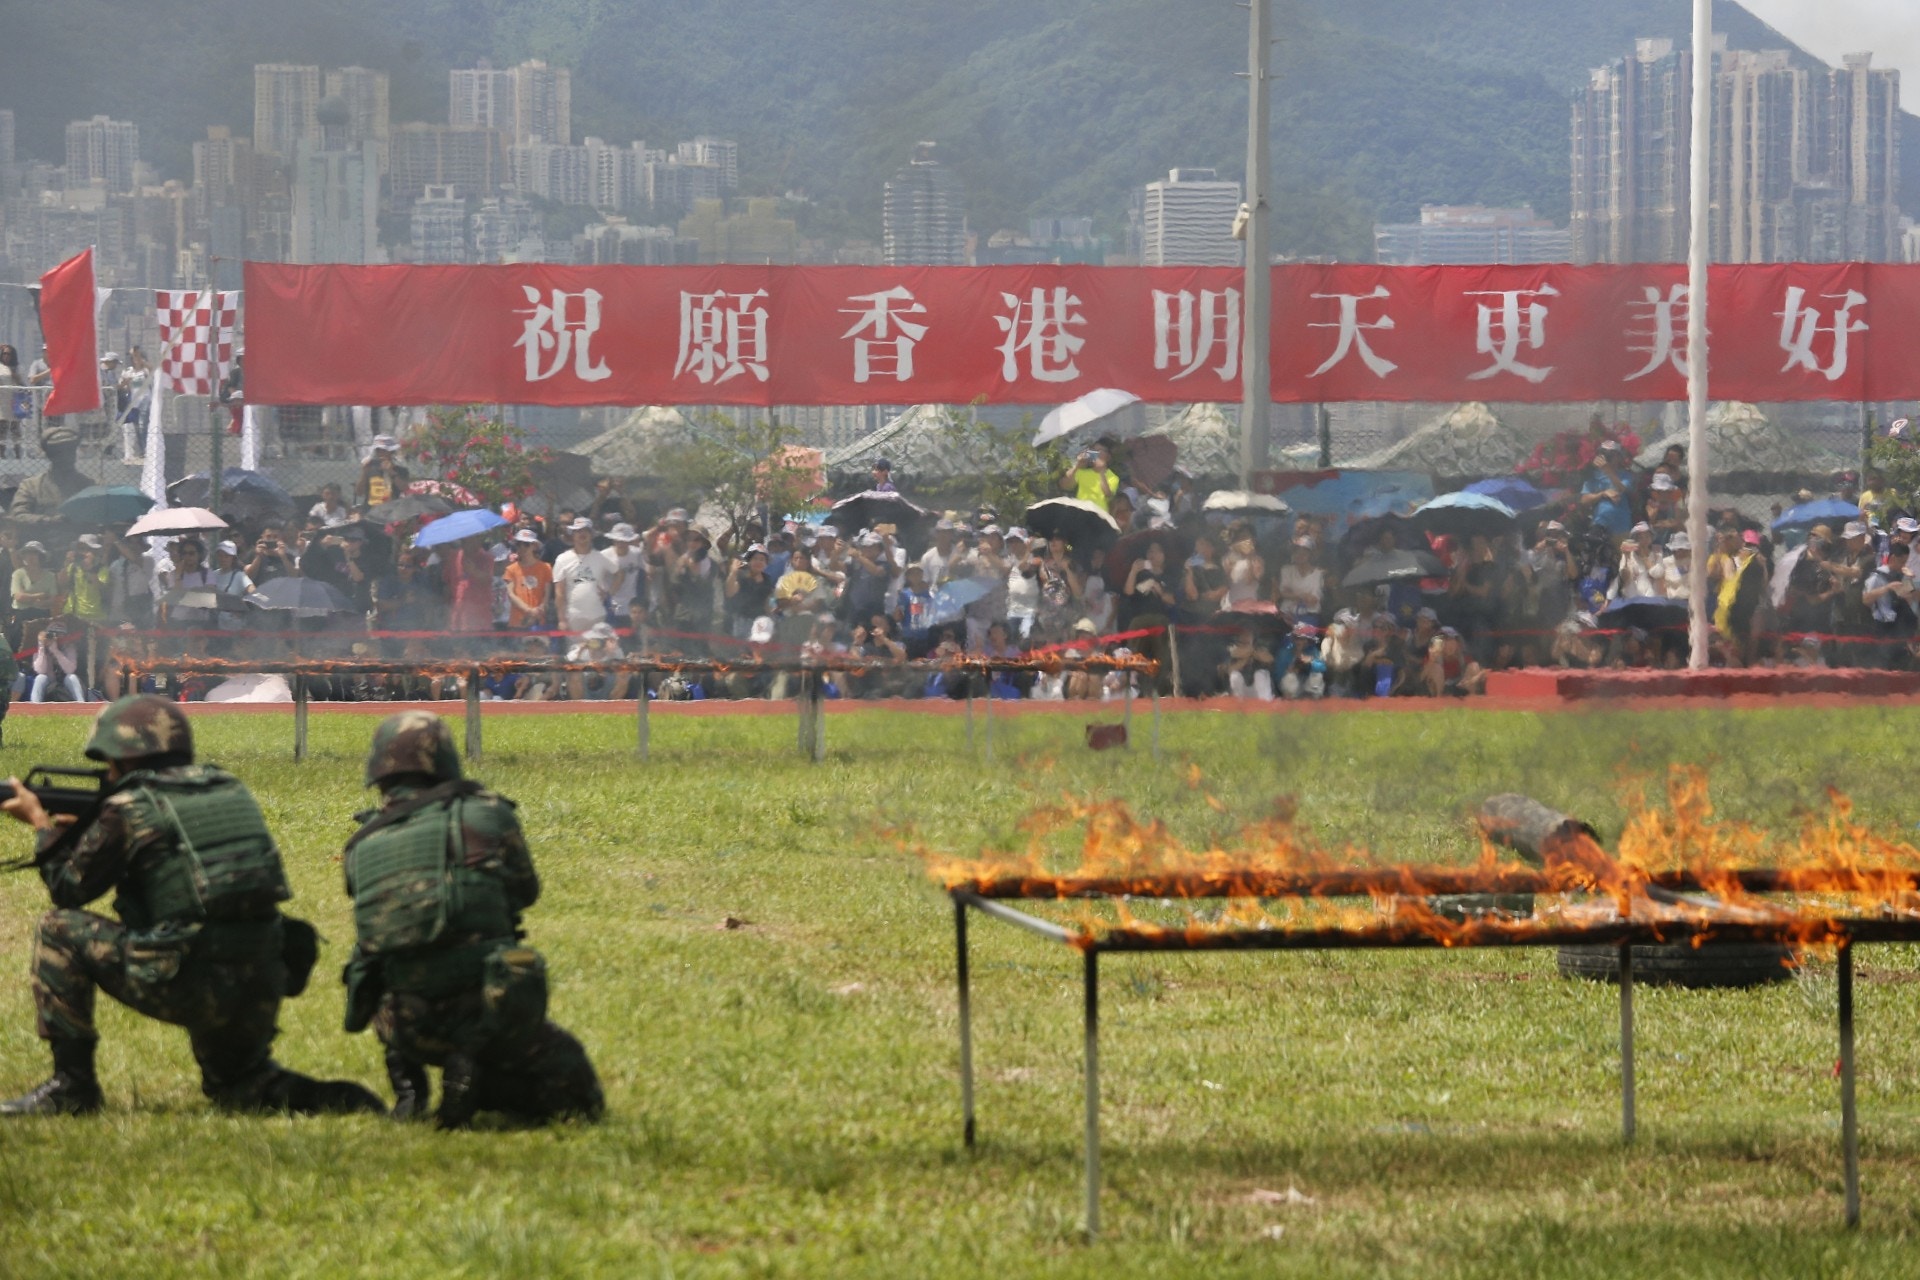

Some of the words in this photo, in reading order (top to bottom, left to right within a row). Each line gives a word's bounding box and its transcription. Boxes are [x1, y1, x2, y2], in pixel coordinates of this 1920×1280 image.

[512, 284, 1869, 385] 祝願香港明天更美好
